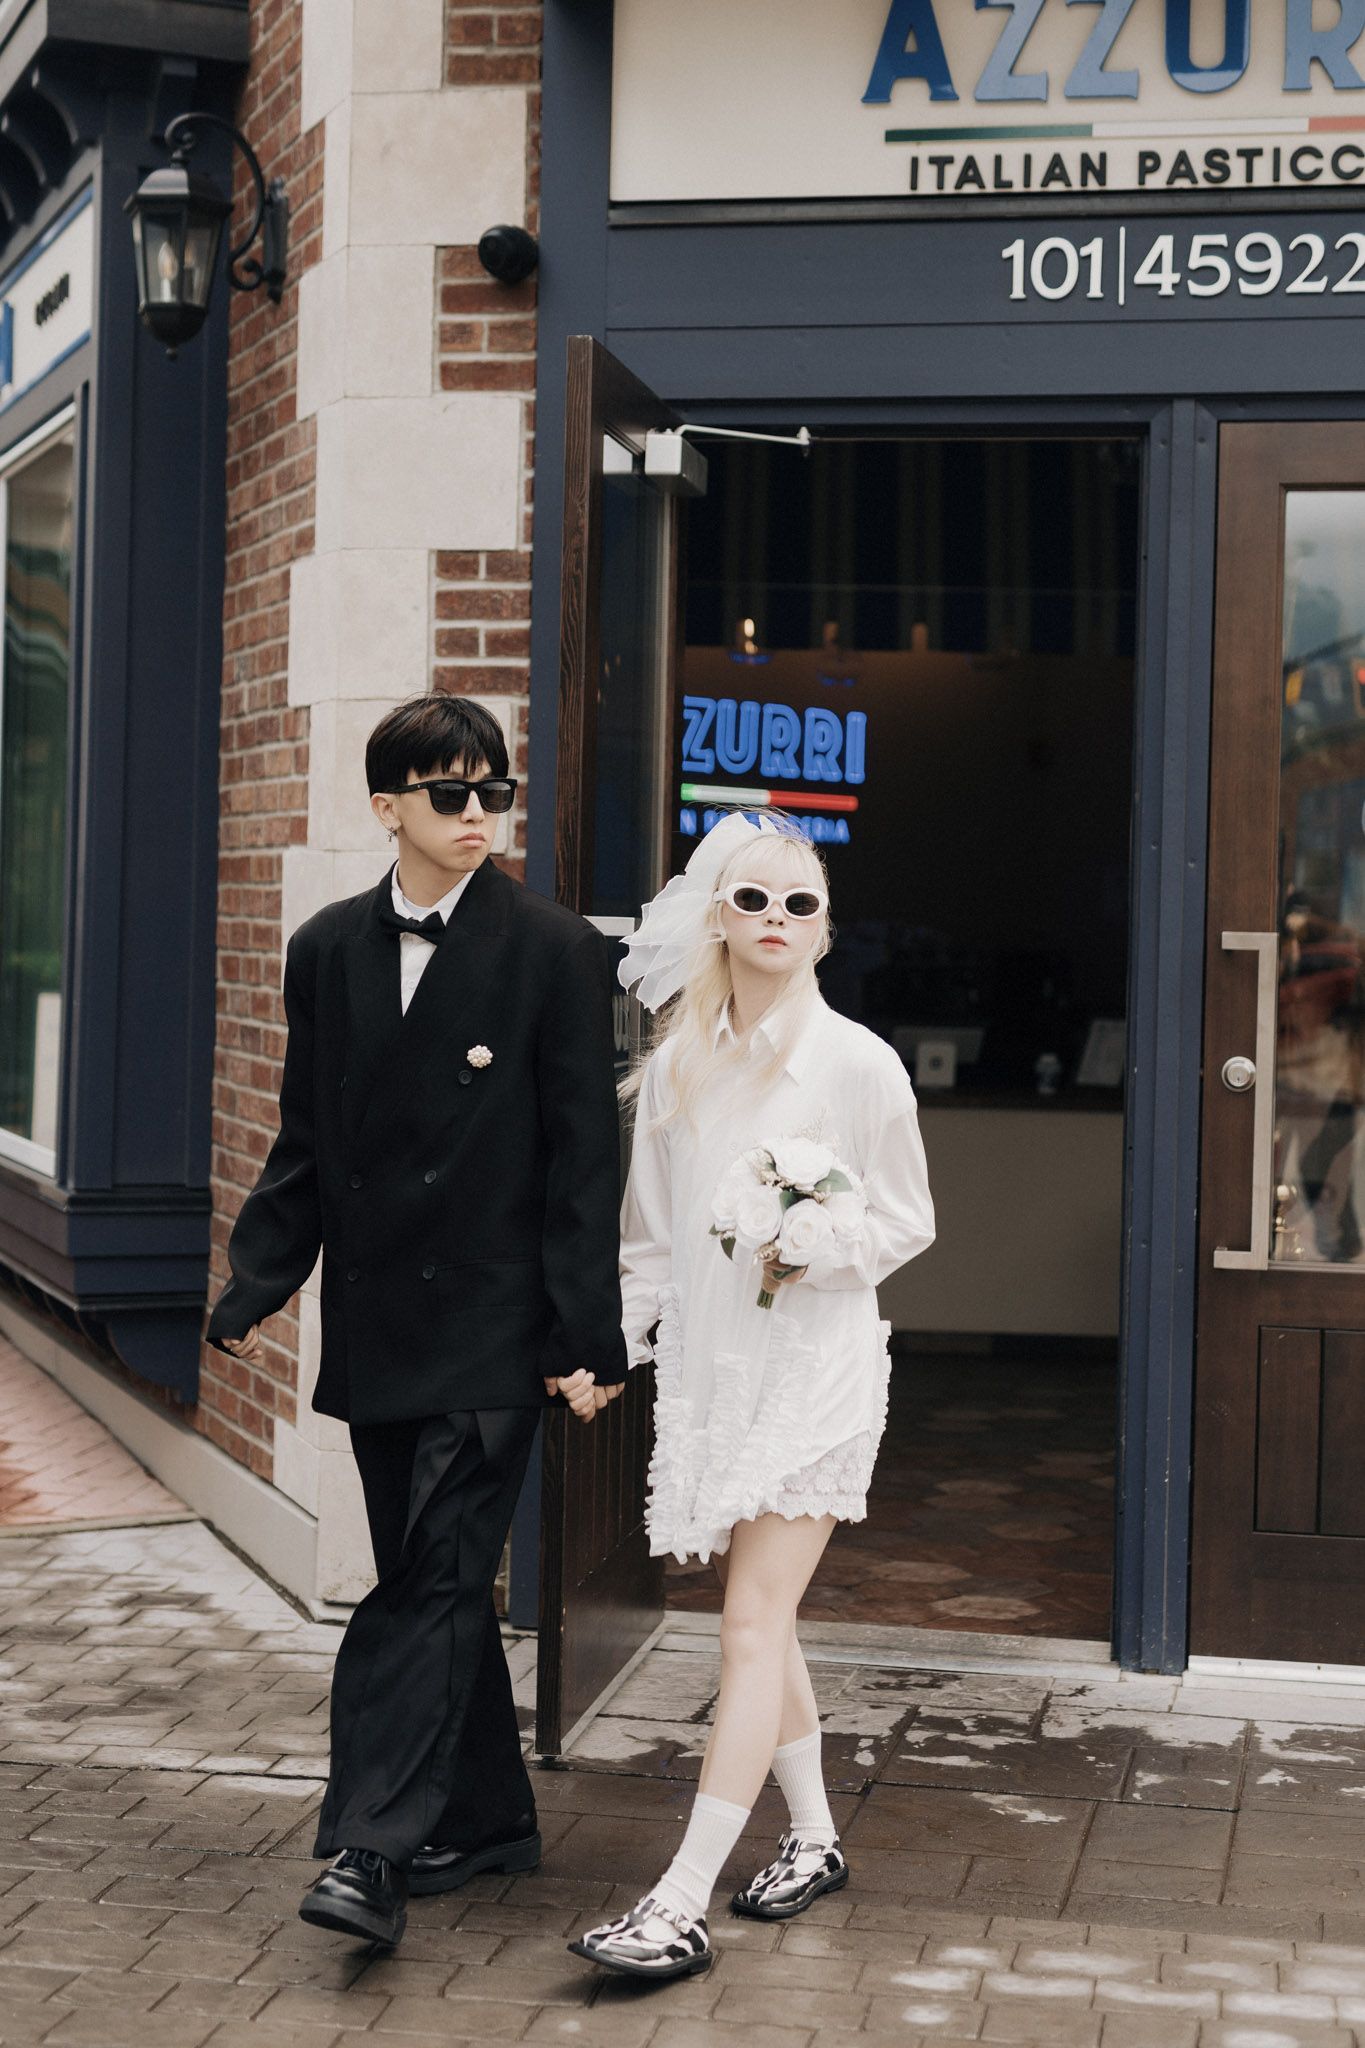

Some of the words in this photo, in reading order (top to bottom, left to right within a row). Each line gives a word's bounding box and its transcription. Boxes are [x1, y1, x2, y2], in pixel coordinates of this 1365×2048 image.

[861, 0, 1365, 103] AZZUR
[909, 150, 1108, 191] ITALIAN
[1137, 144, 1365, 187] PASTICC
[682, 694, 867, 784] ZURRI
